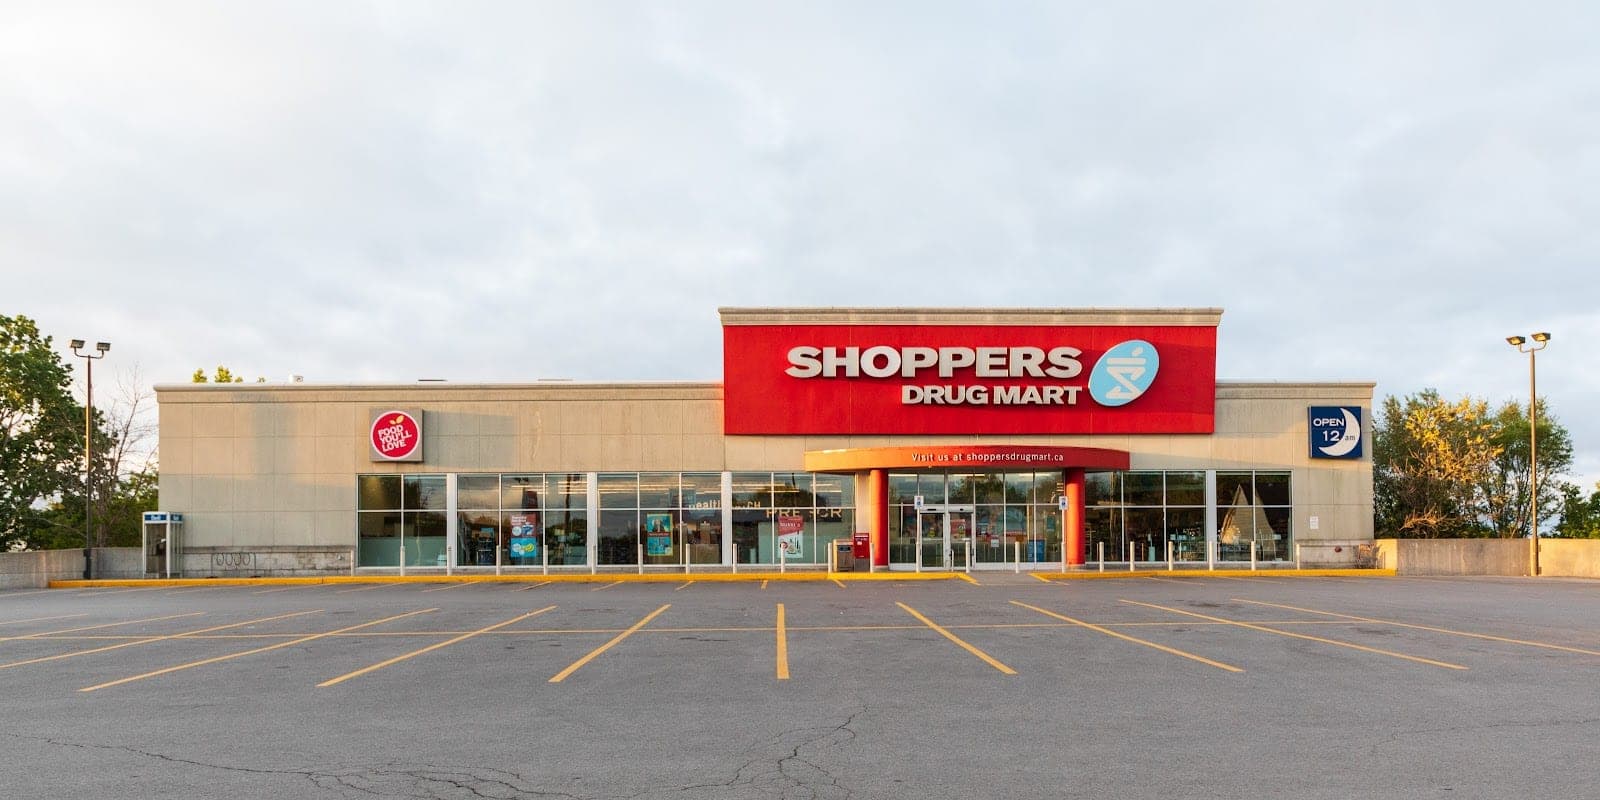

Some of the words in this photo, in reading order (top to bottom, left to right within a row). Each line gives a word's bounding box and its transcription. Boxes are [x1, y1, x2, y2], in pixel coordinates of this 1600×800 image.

[784, 345, 1083, 378] SHOPPERS
[901, 384, 990, 405] DRUG
[993, 385, 1082, 405] MART
[1313, 418, 1345, 427] OPEN
[378, 424, 404, 439] FOOD
[380, 430, 412, 445] YOU'LL
[1322, 430, 1340, 442] 12
[382, 439, 407, 452] LOVE
[912, 452, 934, 462] Visit
[938, 453, 949, 462] us
[953, 452, 963, 462] at
[966, 452, 1064, 463] shoppersdrugmart.ca
